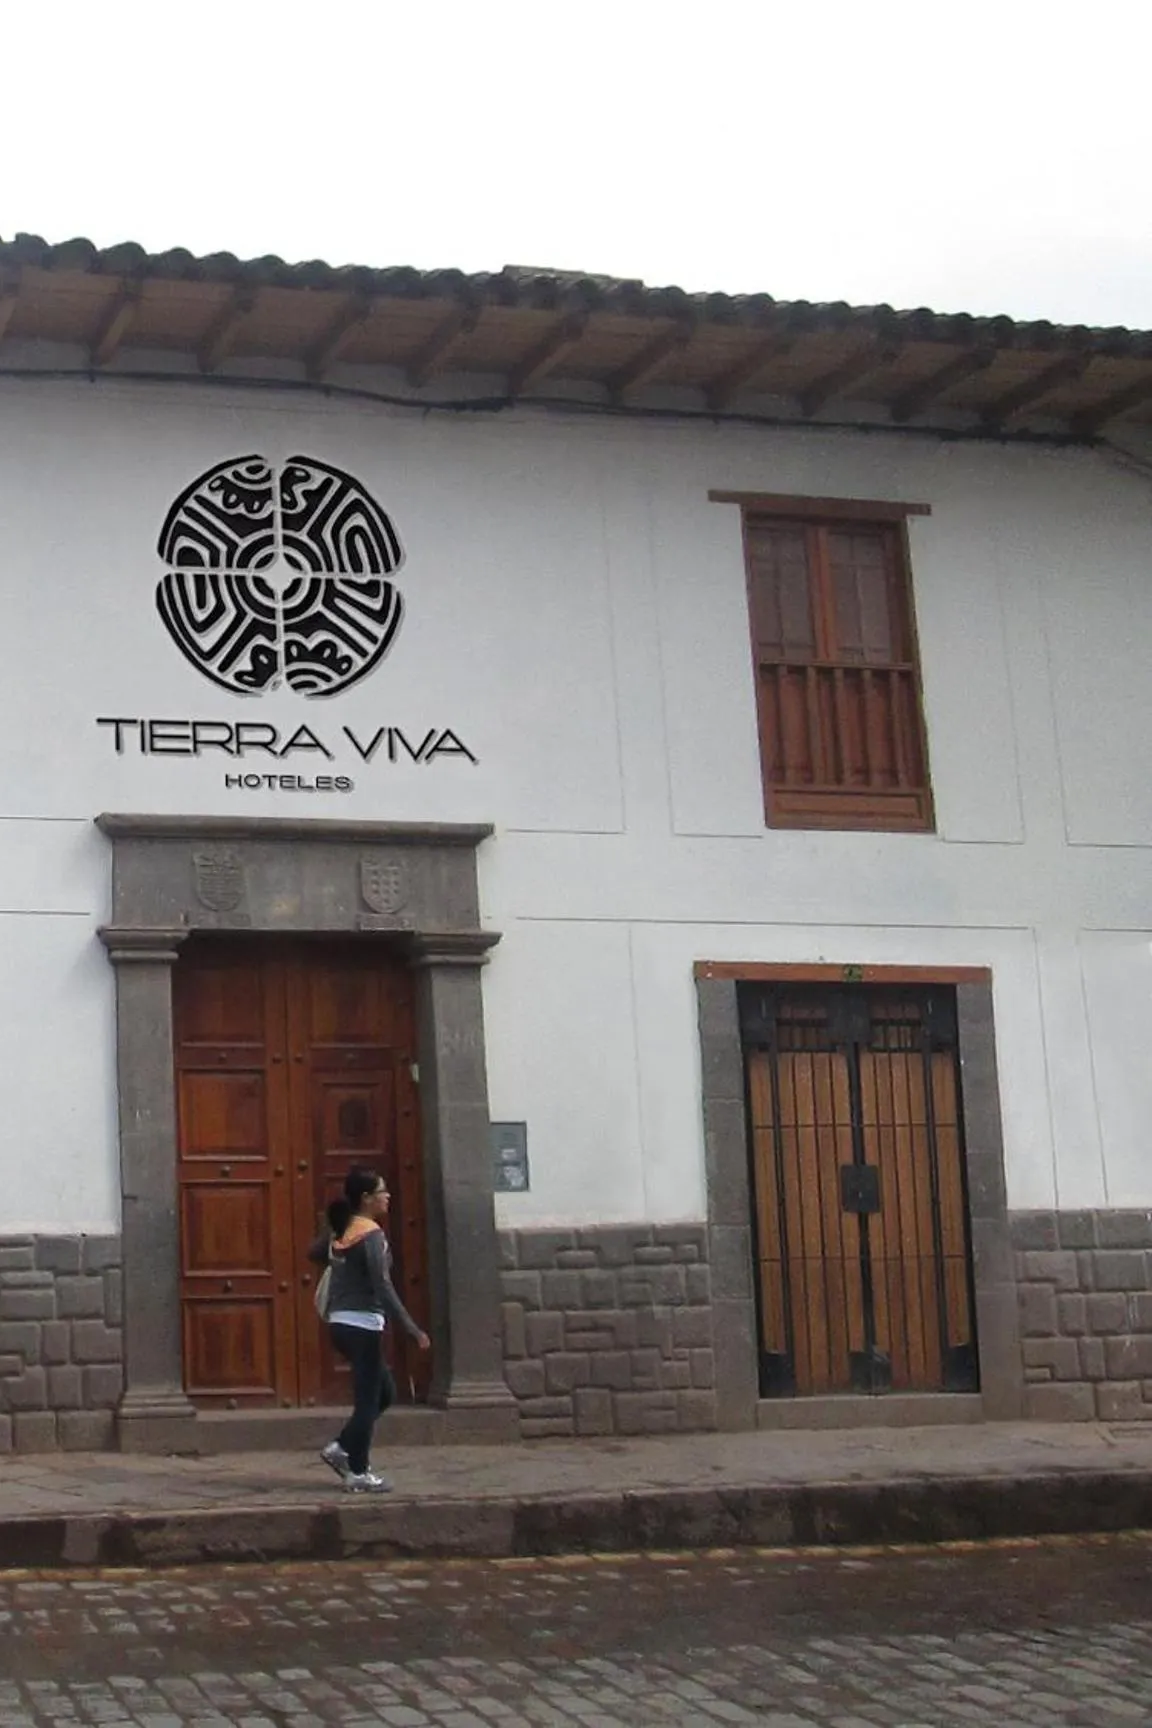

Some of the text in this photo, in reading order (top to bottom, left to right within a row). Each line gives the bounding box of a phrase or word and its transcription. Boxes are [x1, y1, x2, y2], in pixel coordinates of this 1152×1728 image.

[96, 717, 478, 763] TIERRA VIVA
[224, 773, 352, 791] HOTELES
